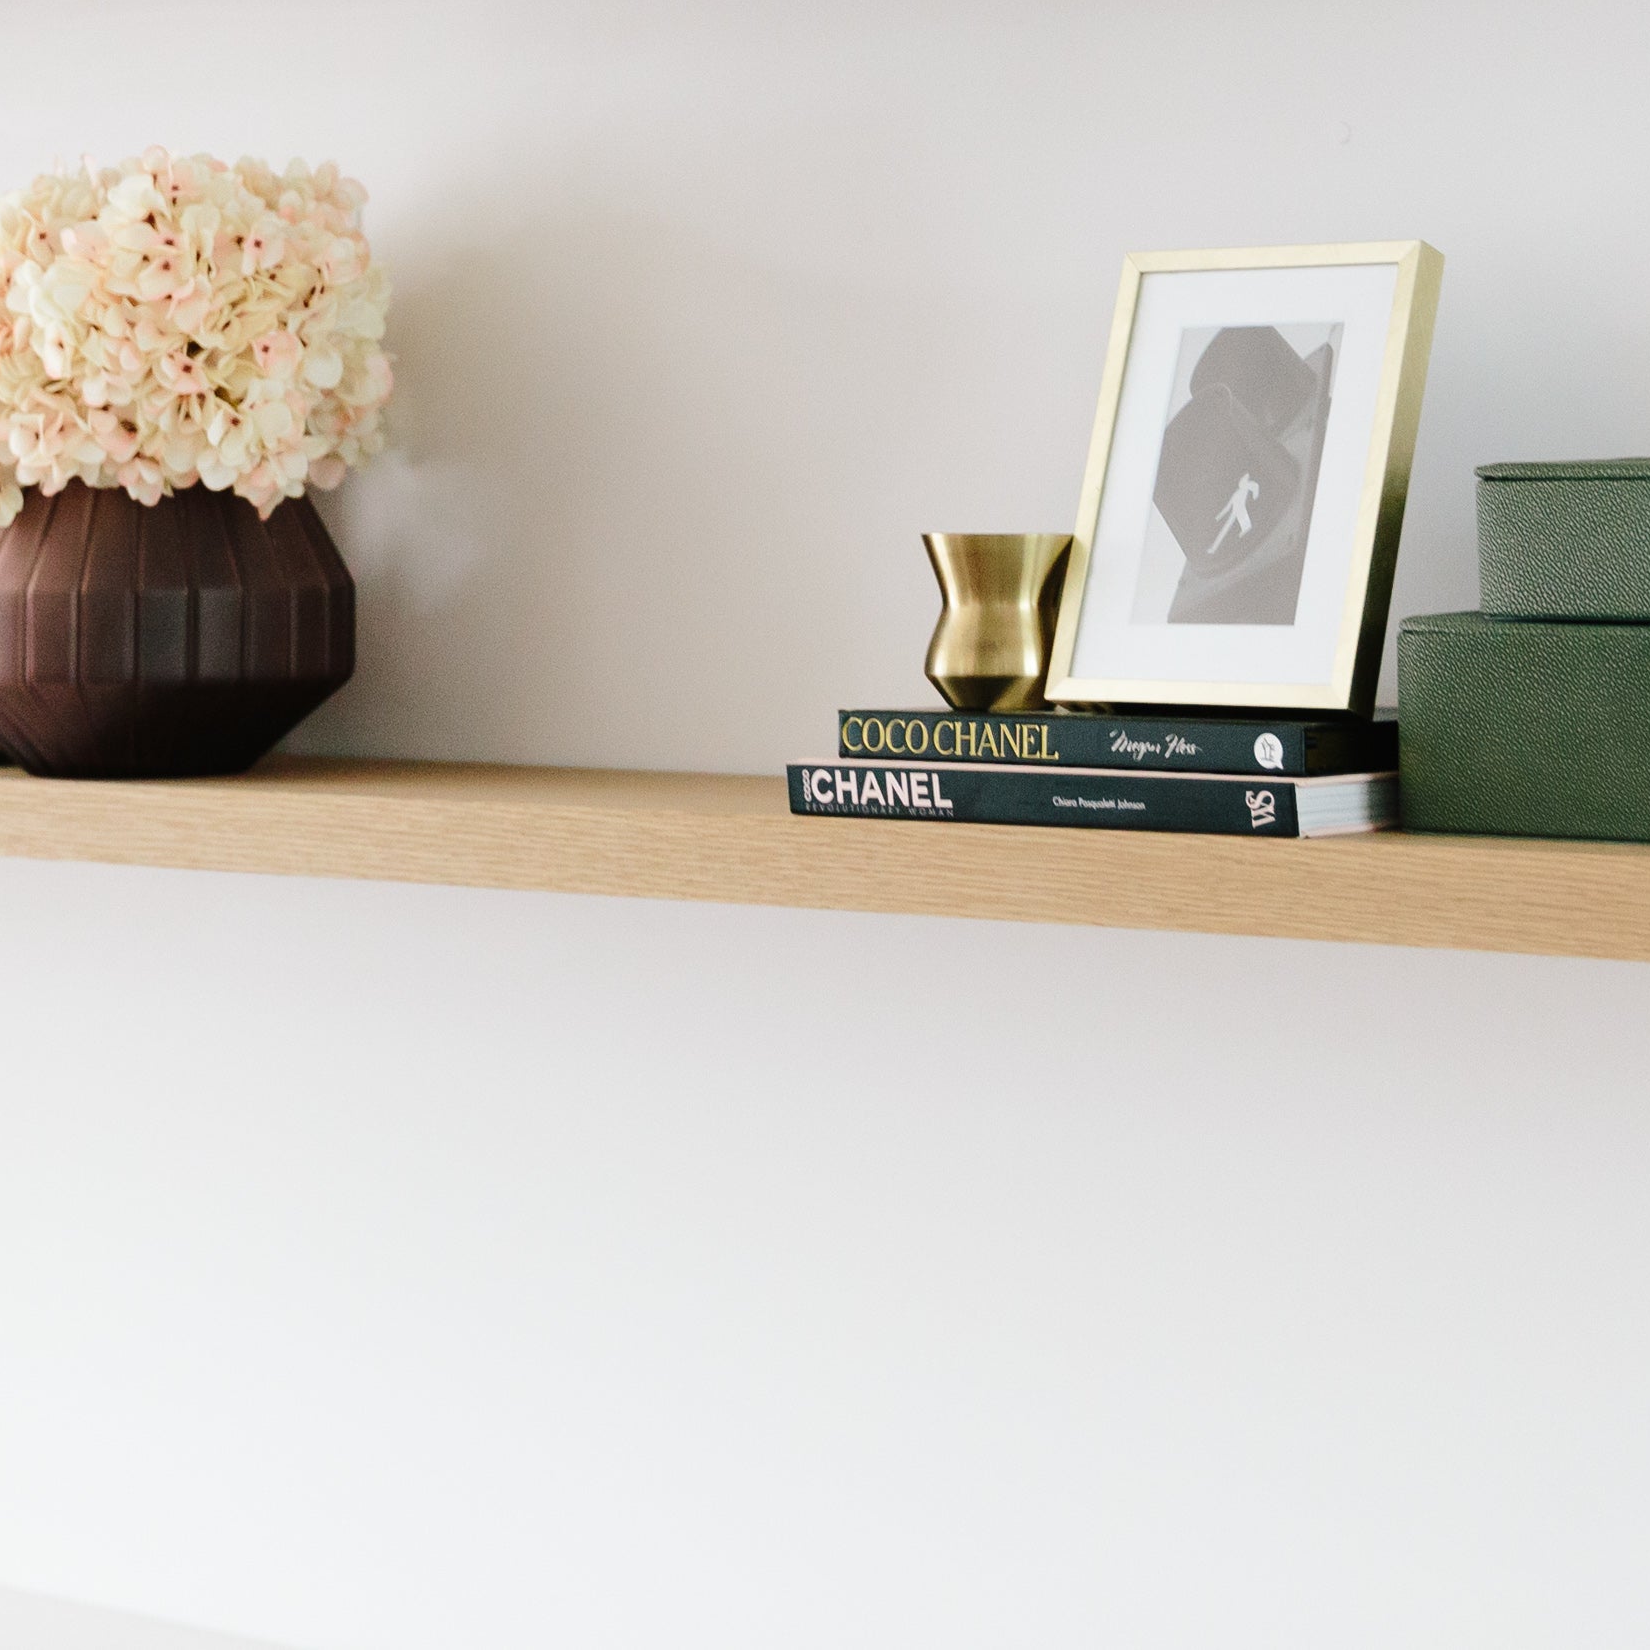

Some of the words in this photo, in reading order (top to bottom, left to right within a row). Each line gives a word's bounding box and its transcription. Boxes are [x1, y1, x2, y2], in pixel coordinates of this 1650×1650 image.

[842, 716, 929, 754] COCO
[933, 720, 1060, 760] CHANEL
[801, 768, 812, 802] COCO
[811, 768, 954, 808] CHANEL
[805, 803, 900, 815] REVOLUTIONARY
[908, 807, 954, 817] WOMAN
